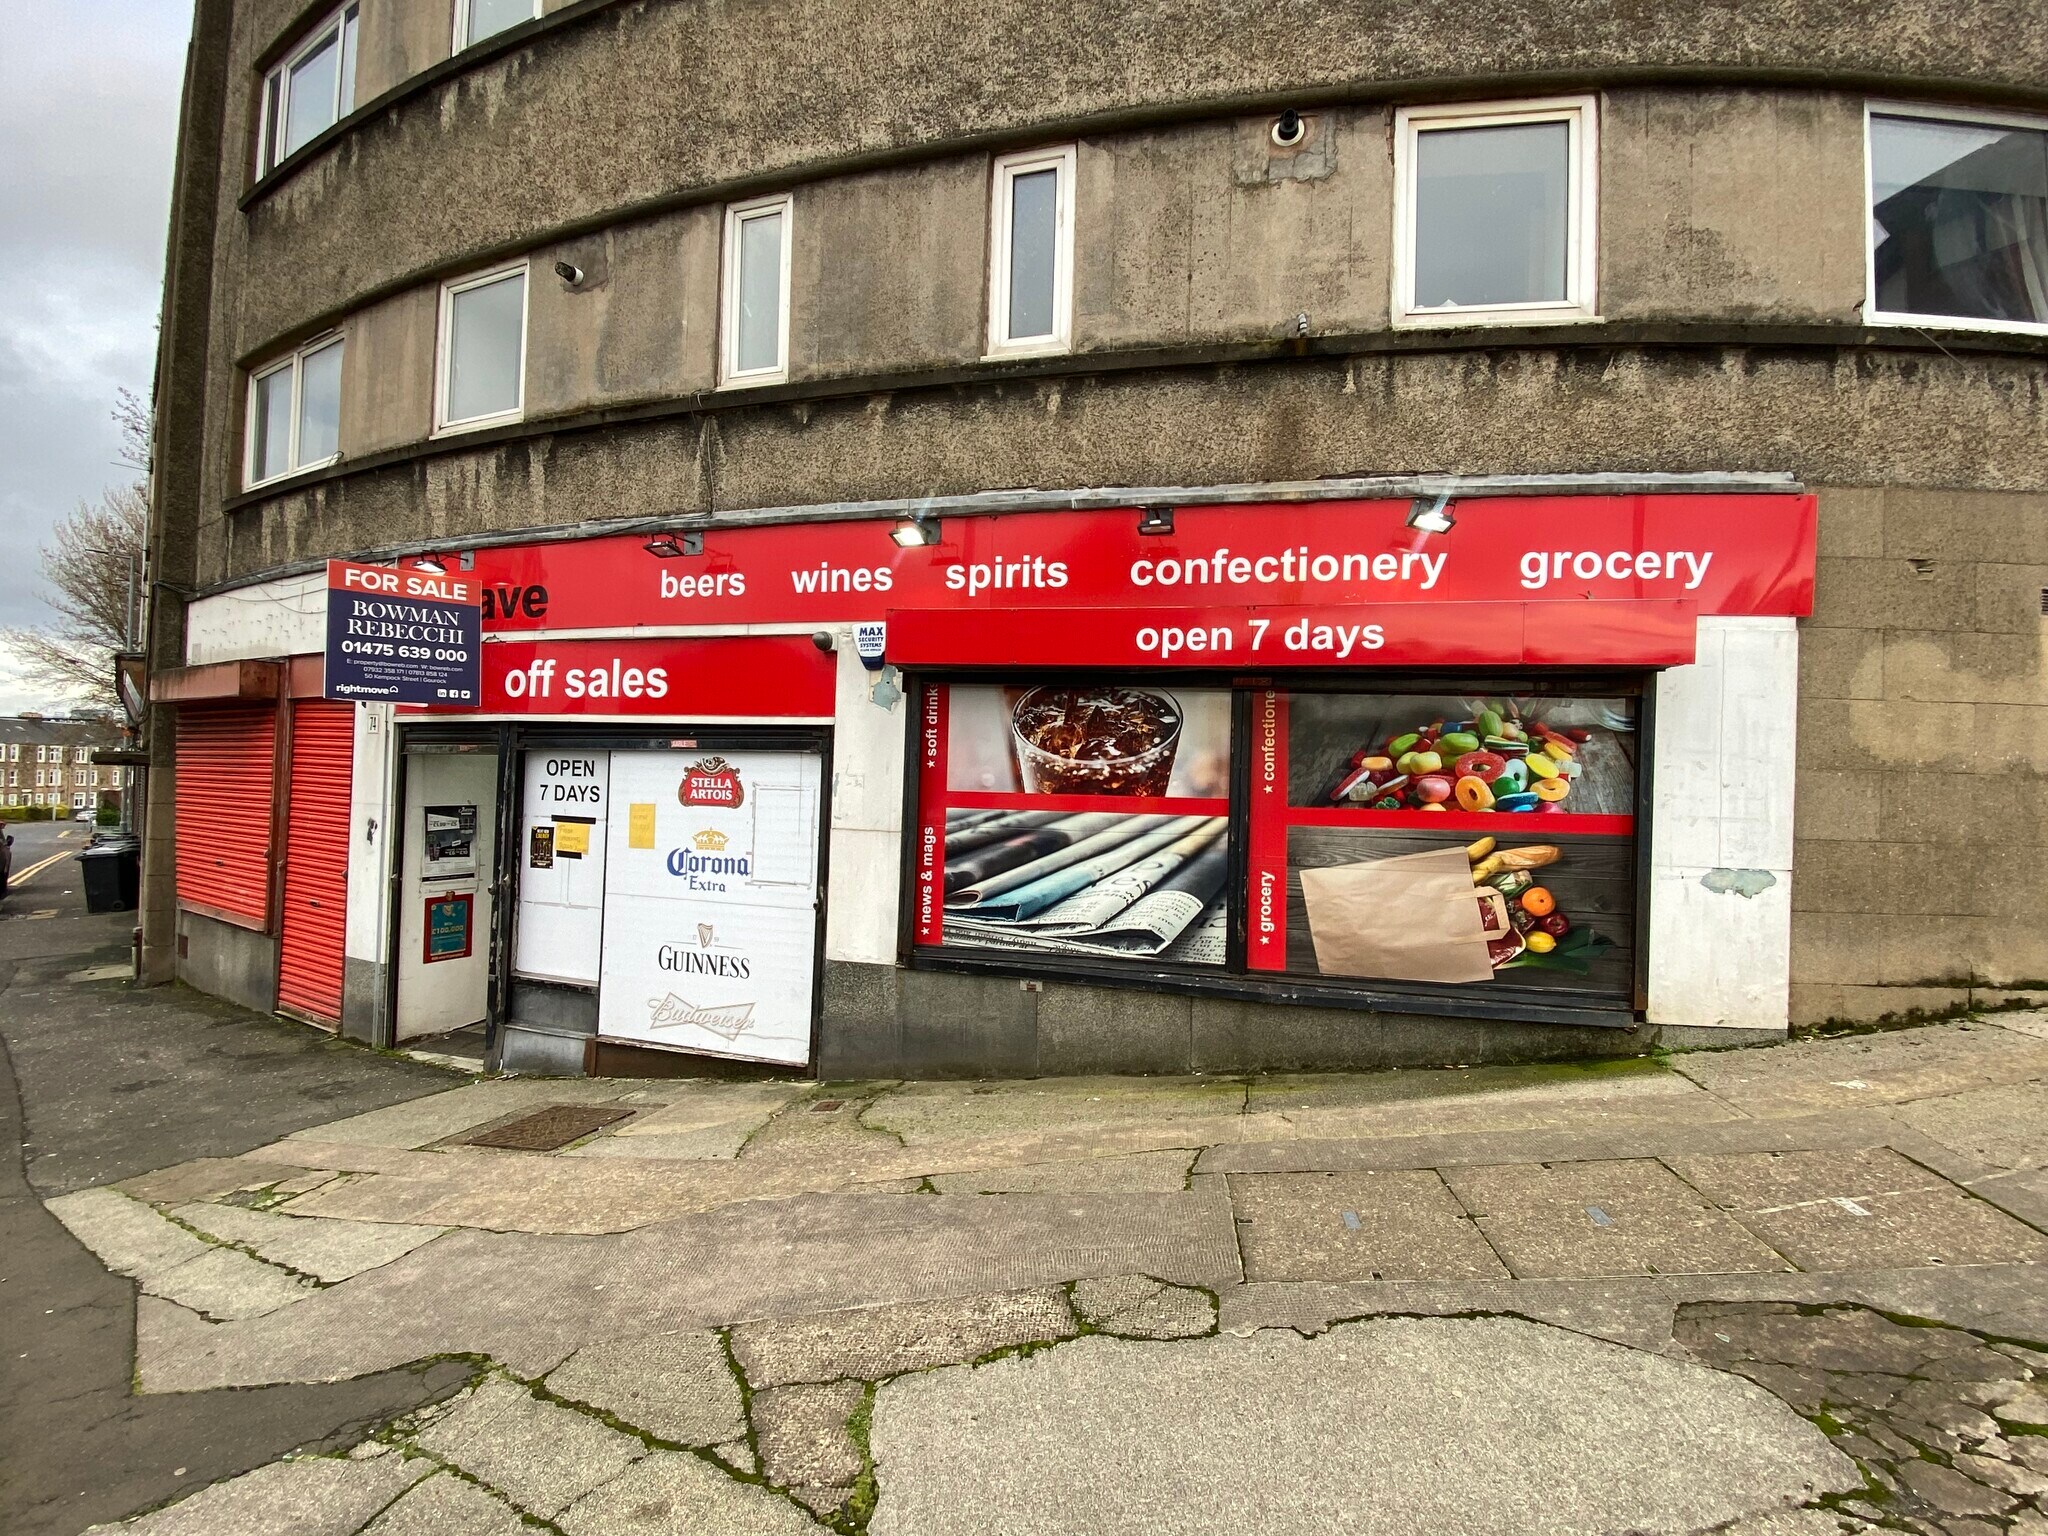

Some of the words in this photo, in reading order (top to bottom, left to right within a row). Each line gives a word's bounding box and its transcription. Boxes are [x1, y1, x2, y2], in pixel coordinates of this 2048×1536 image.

[344, 568, 399, 593] FOR
[406, 577, 468, 601] SALE
[660, 568, 746, 599] beers
[791, 561, 893, 593] wines
[945, 556, 1069, 595] spirits
[1130, 547, 1447, 589] confectionery
[1520, 548, 1713, 591] grocery
[352, 600, 460, 626] BOWMAN
[346, 618, 464, 645] REBECCHI
[859, 626, 884, 636] MAX
[1135, 625, 1234, 660] open
[1248, 620, 1269, 652] 7
[1283, 618, 1385, 659] days
[341, 640, 395, 657] 01475
[398, 645, 431, 660] 639
[435, 648, 468, 662] 000
[336, 683, 389, 695] rightmove
[505, 659, 555, 698] off
[565, 658, 668, 698] sales
[926, 728, 938, 756] soft
[546, 759, 596, 778] OPEN
[540, 784, 549, 801] 7
[554, 785, 601, 803] DAYS
[689, 788, 733, 802] ARTOIS
[690, 776, 732, 790] STELLA
[923, 826, 936, 867] mags
[666, 847, 750, 880] Corona
[920, 870, 932, 881] &
[688, 876, 726, 892] Extra
[921, 885, 932, 924] news
[1260, 872, 1276, 934] grocery
[658, 944, 750, 980] GUINNESS
[647, 998, 756, 1030] Budweiser
